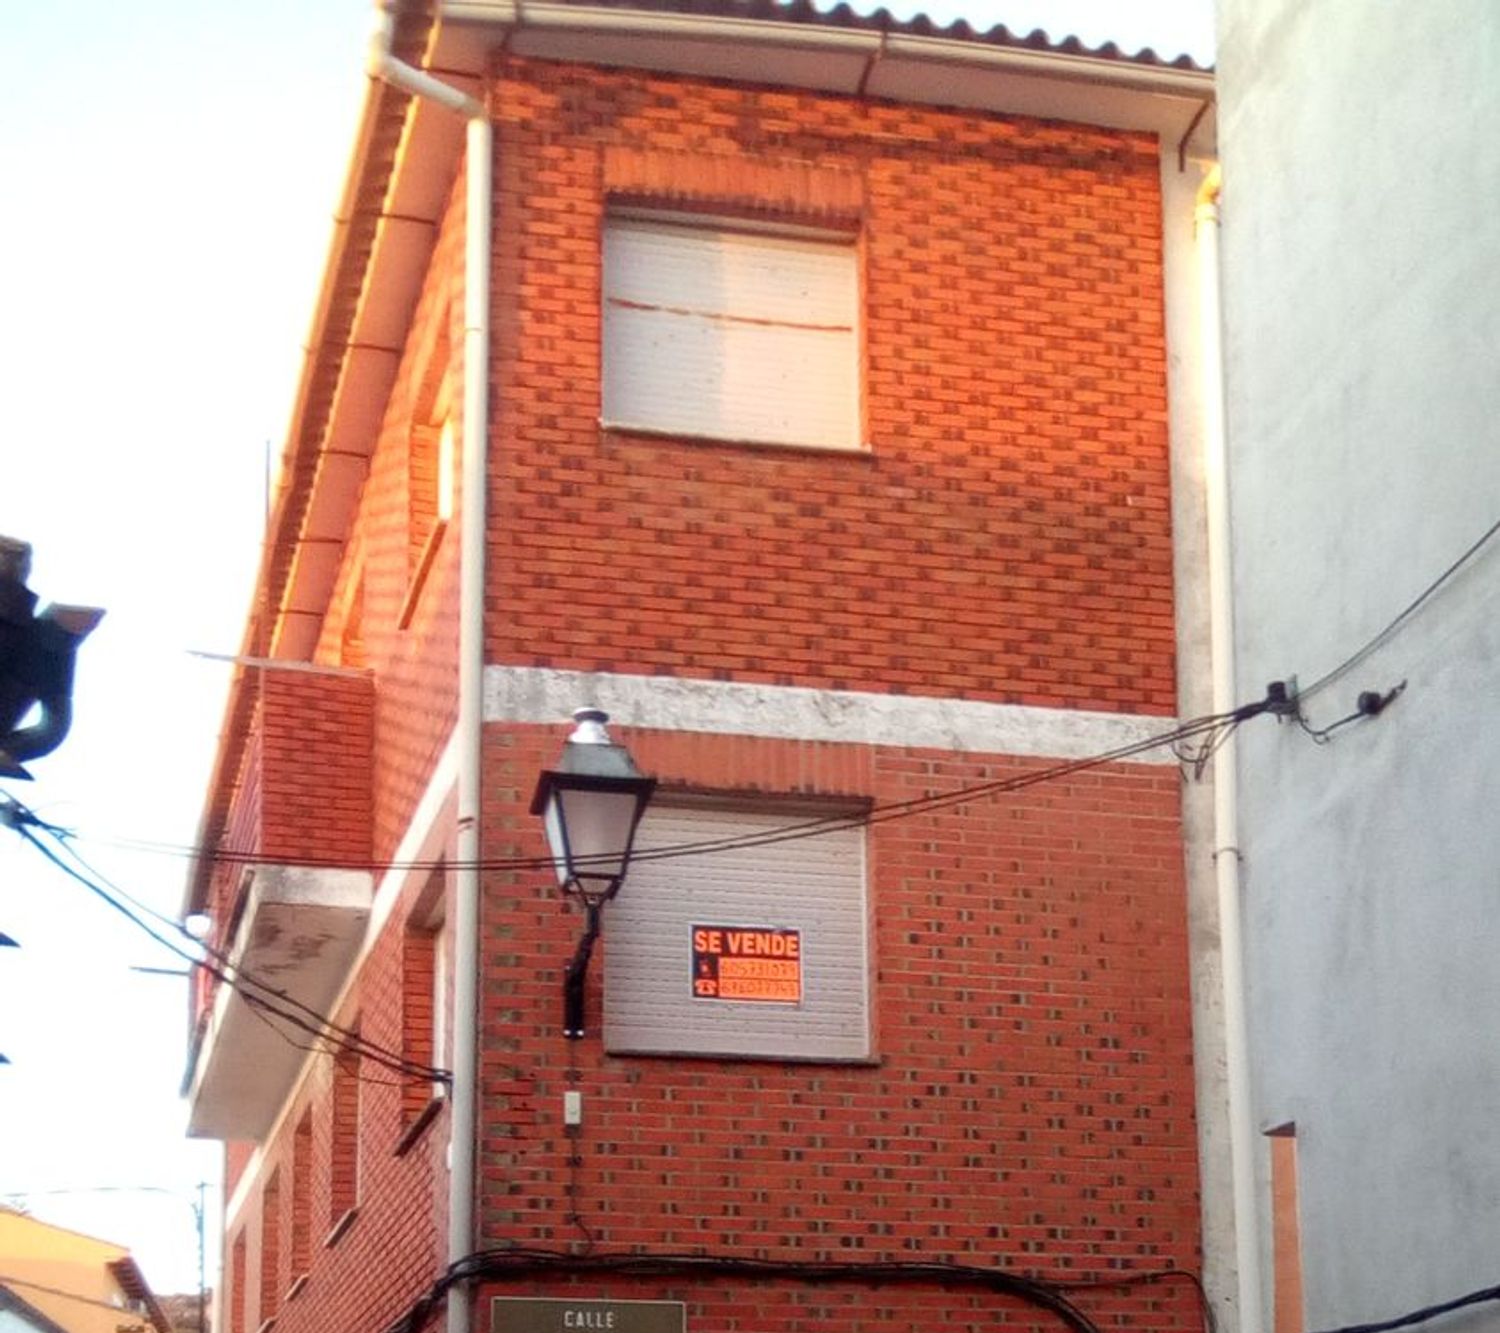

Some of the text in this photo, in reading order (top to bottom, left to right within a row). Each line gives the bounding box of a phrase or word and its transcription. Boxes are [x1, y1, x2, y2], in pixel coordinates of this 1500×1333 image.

[695, 931, 799, 957] SE VENDE
[564, 1310, 614, 1328] CALLE
